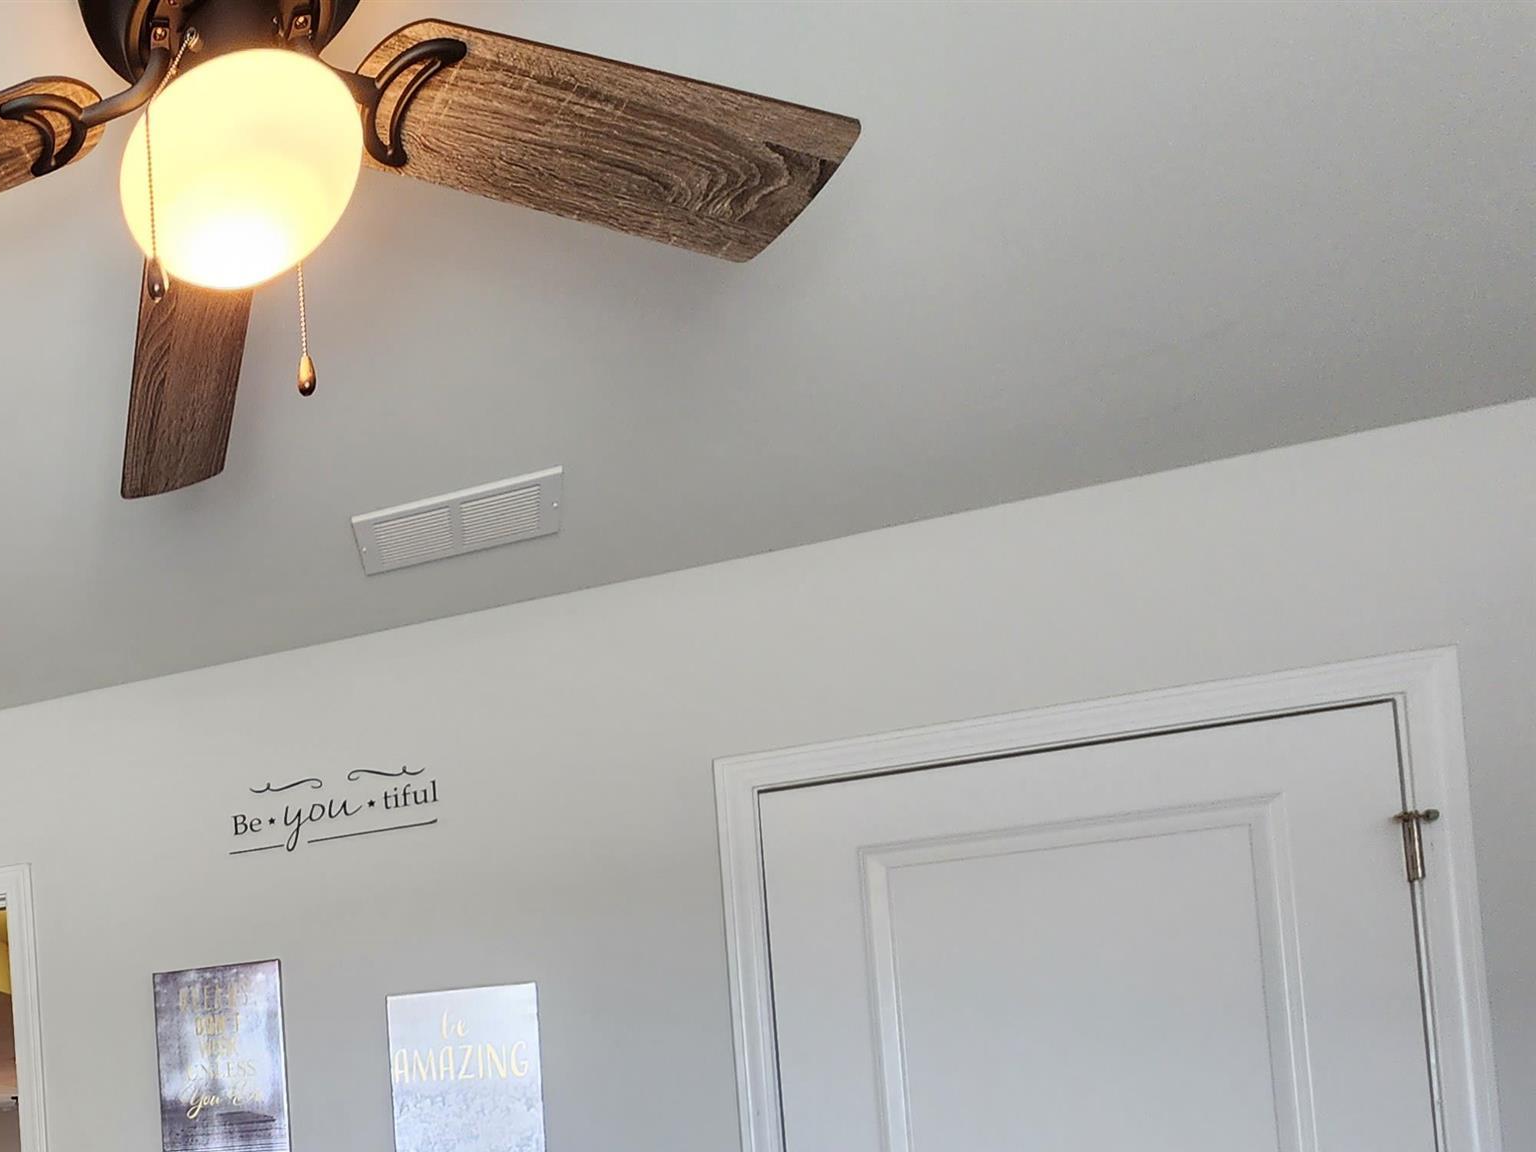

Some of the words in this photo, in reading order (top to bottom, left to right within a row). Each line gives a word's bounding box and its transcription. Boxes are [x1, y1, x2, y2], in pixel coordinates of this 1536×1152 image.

[232, 814, 262, 836] Be
[283, 799, 363, 852] you
[383, 780, 439, 810] tiful
[394, 1040, 529, 1084] AMAZING
